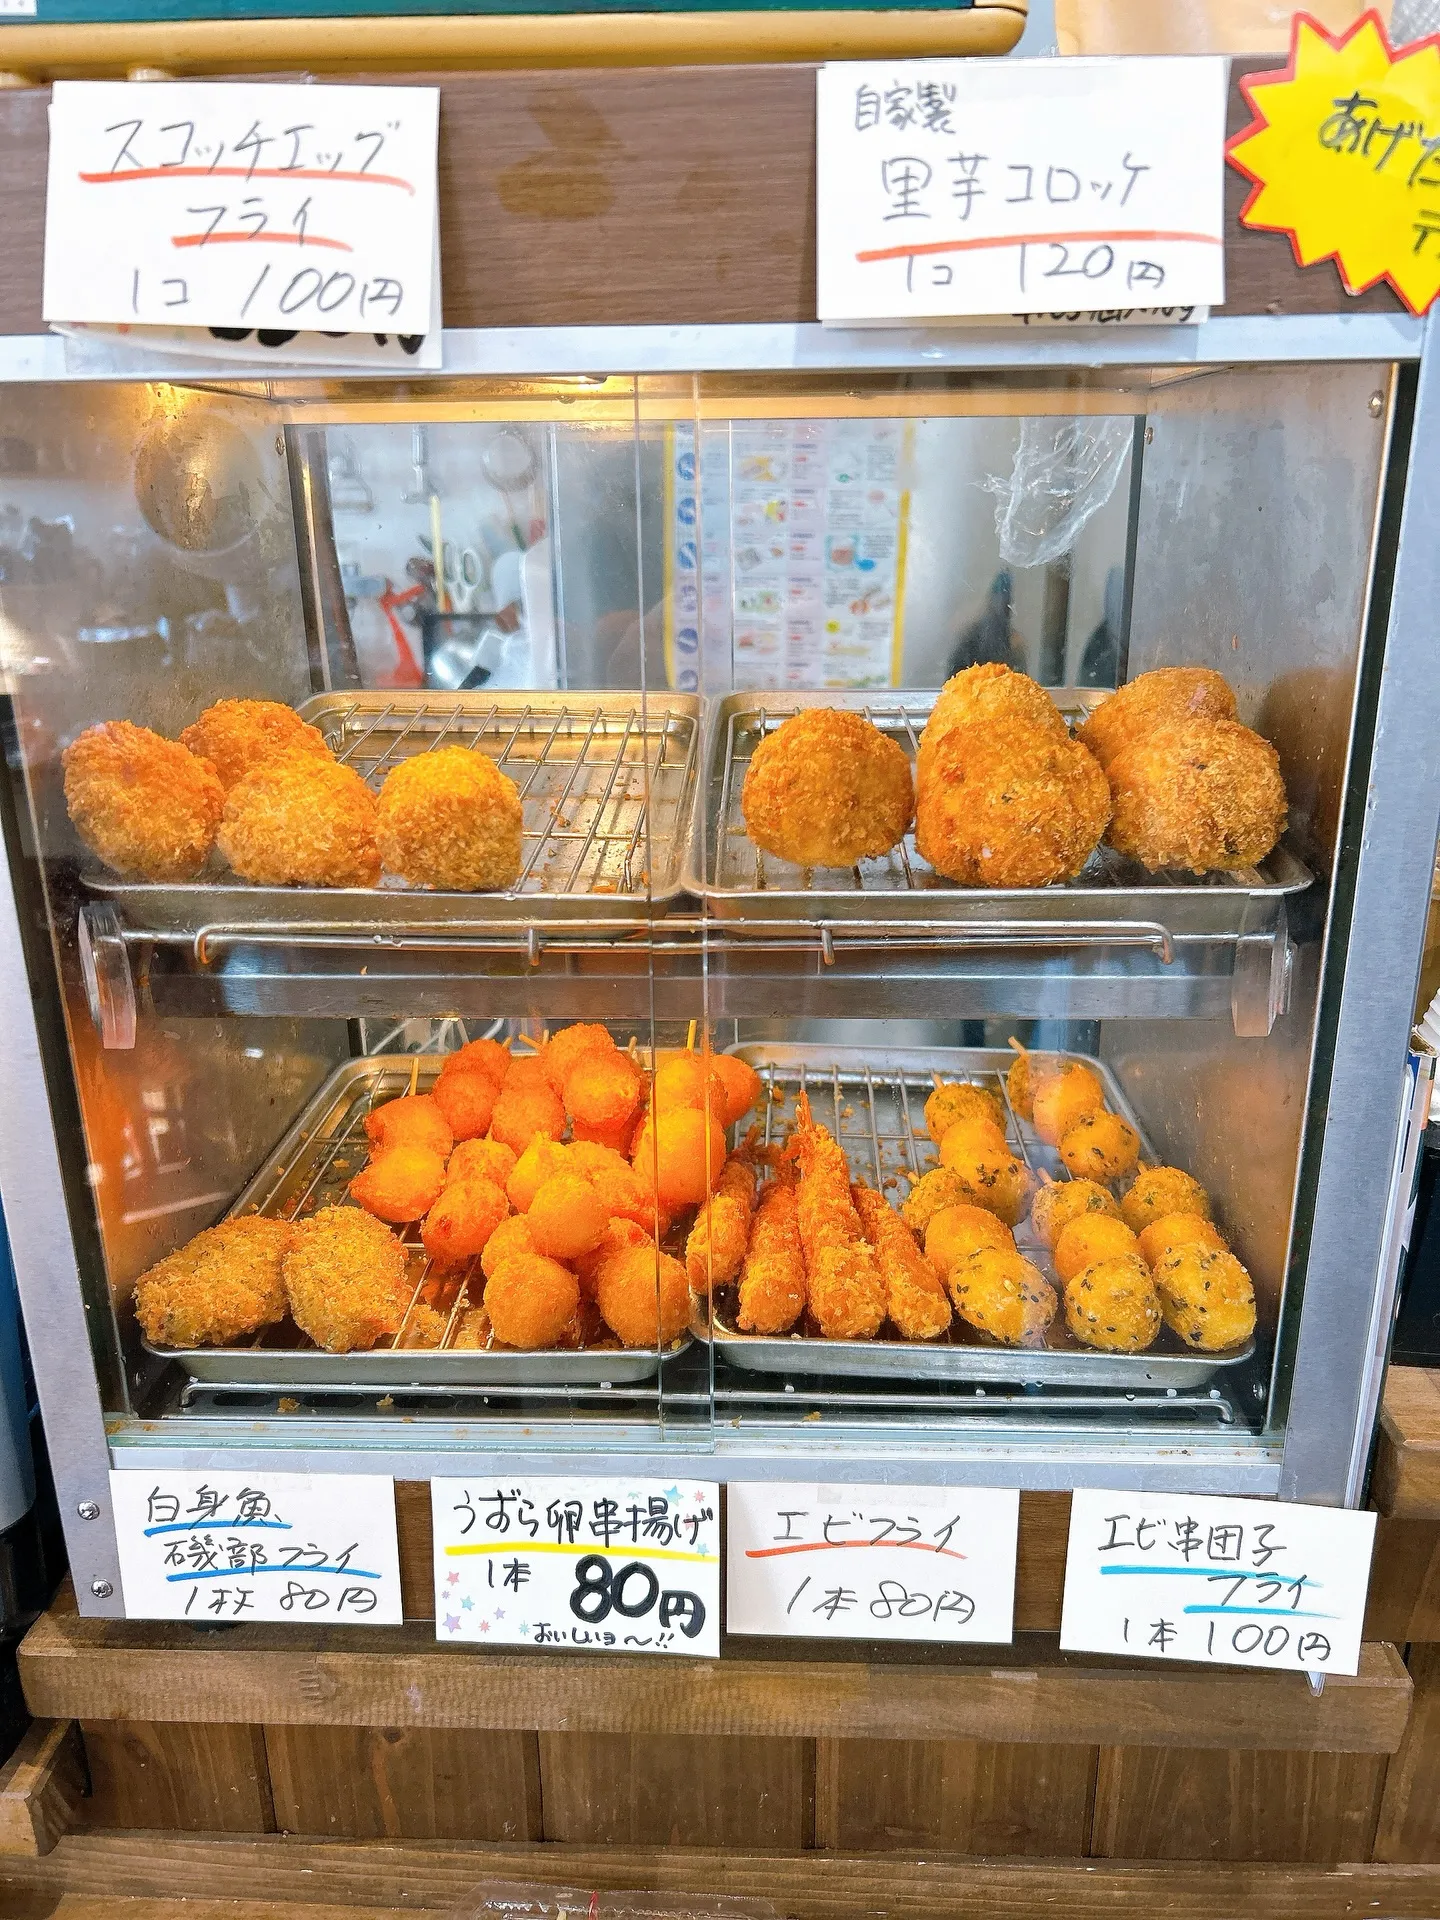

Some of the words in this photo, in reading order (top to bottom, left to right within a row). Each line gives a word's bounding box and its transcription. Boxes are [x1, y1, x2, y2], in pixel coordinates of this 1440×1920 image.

[855, 79, 956, 134] 自家製
[105, 118, 402, 182] スコッチエッグ
[881, 152, 1151, 222] 里芋コロッケ
[186, 197, 312, 247] フライ
[240, 264, 403, 318] 100円
[1018, 242, 1166, 293] 120円
[148, 1484, 283, 1530] 白身魚
[453, 1489, 713, 1548] うずら卵串揚げ
[773, 1511, 961, 1553] エビフライ
[164, 1534, 359, 1575] 磯部フライ
[1097, 1514, 1288, 1567] エビ串団子
[487, 1557, 532, 1593] 1本
[569, 1554, 706, 1639] 80円
[1207, 1572, 1307, 1610] フライ
[1207, 1620, 1332, 1662] 100円
